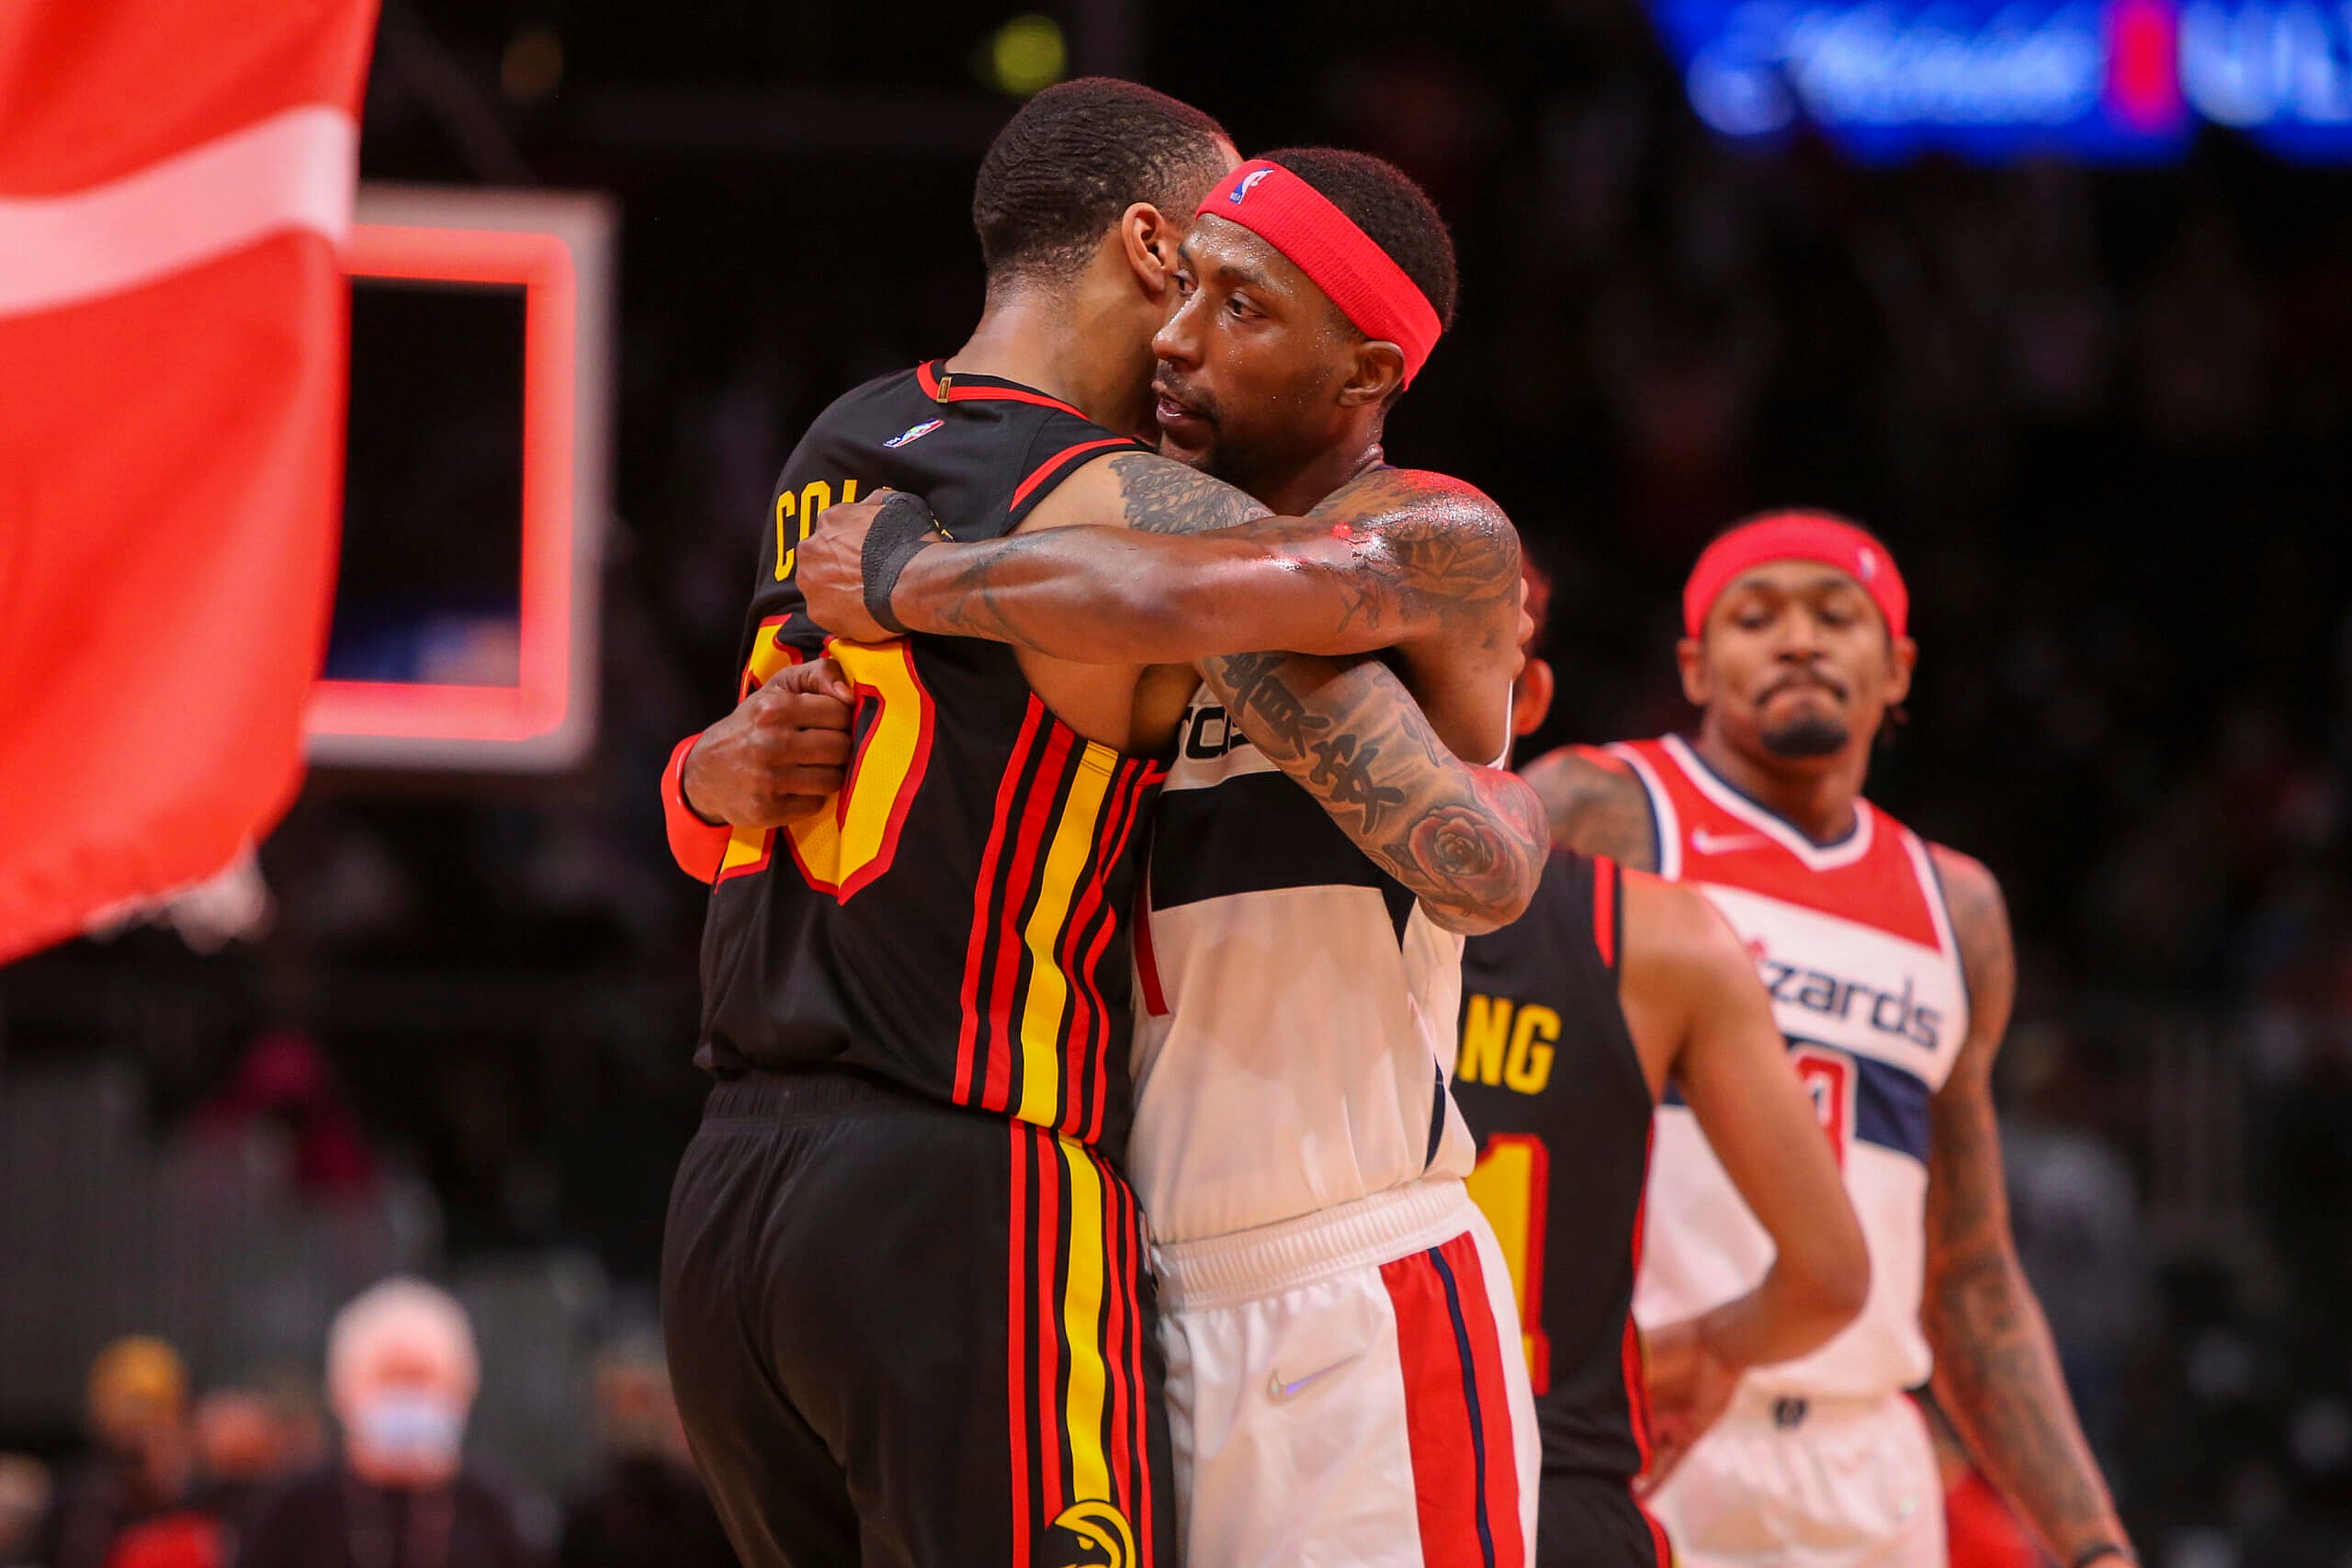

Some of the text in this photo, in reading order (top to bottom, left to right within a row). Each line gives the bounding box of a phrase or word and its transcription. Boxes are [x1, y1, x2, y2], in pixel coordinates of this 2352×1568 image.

[775, 479, 859, 581] CO
[1455, 992, 1562, 1095] NG
[1748, 941, 1941, 1051] zards
